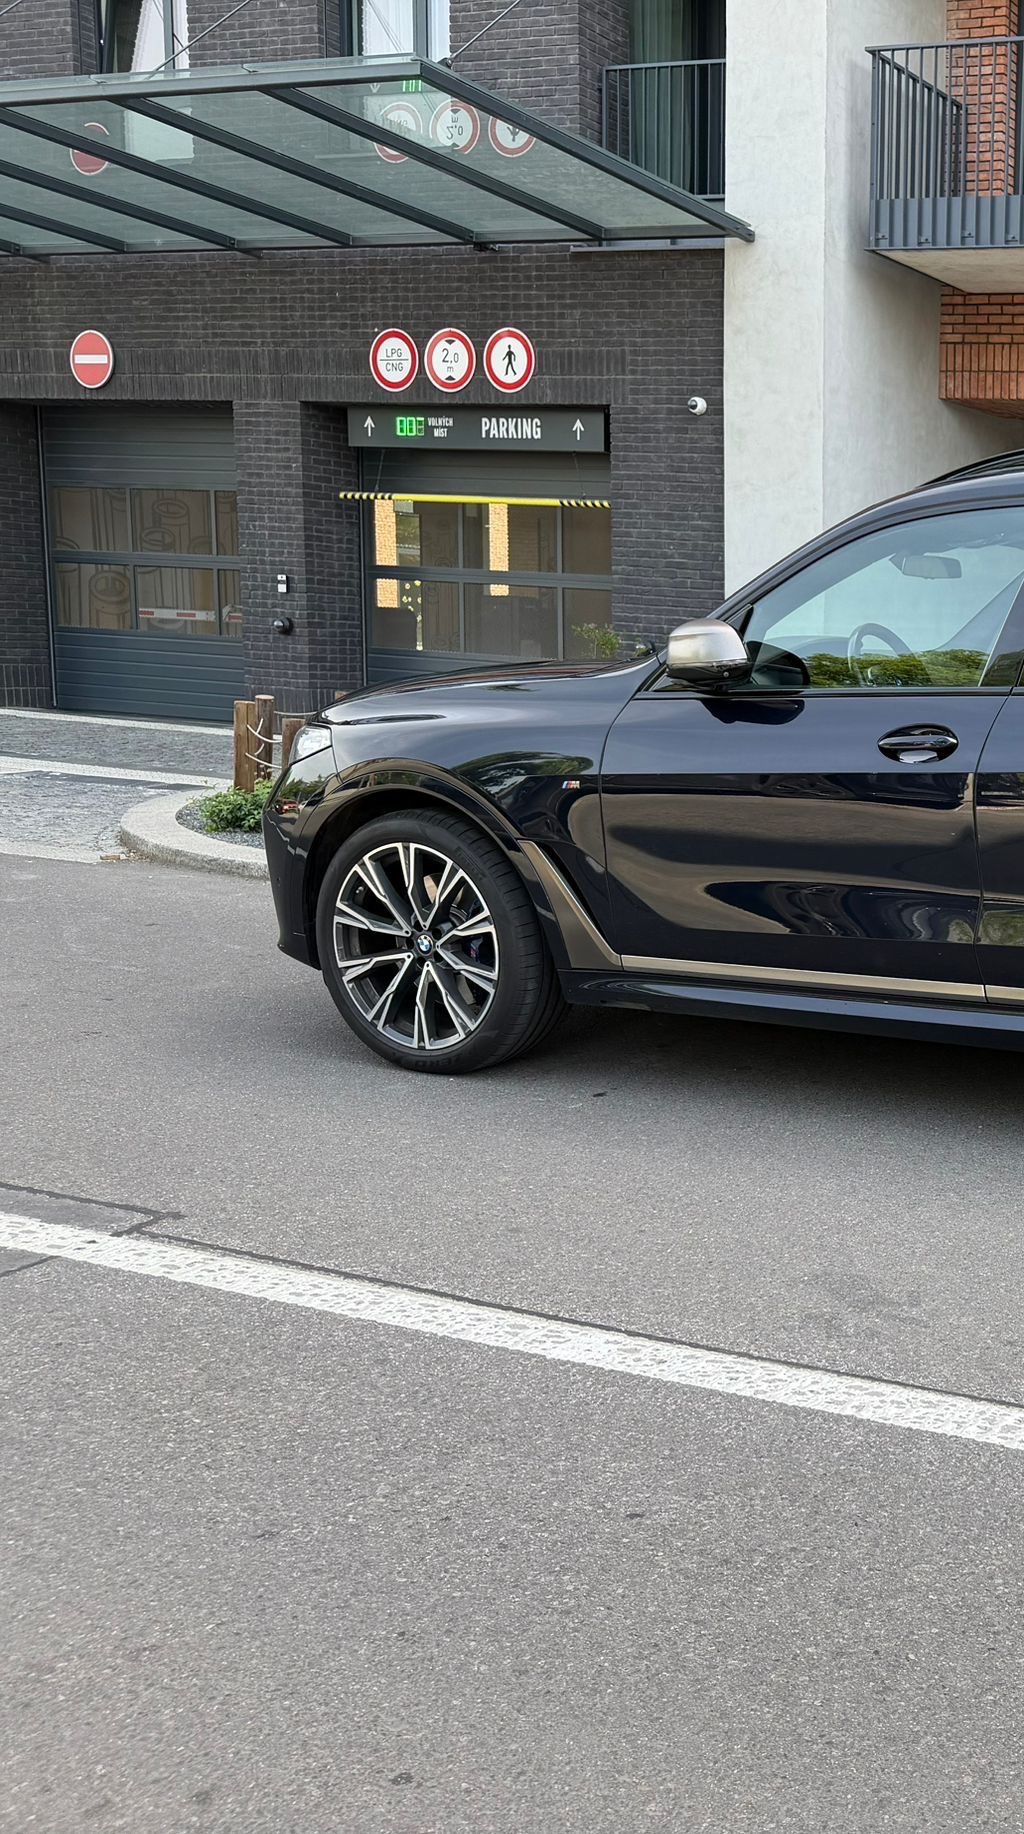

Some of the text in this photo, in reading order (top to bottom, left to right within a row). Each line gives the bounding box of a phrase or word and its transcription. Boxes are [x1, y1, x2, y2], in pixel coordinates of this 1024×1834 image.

[385, 348, 402, 358] LPG
[442, 348, 459, 363] 2,0
[385, 362, 403, 372] CNG
[427, 415, 454, 427] VOLNÝCH
[434, 427, 447, 438] MÍST
[481, 416, 541, 440] PARKING
